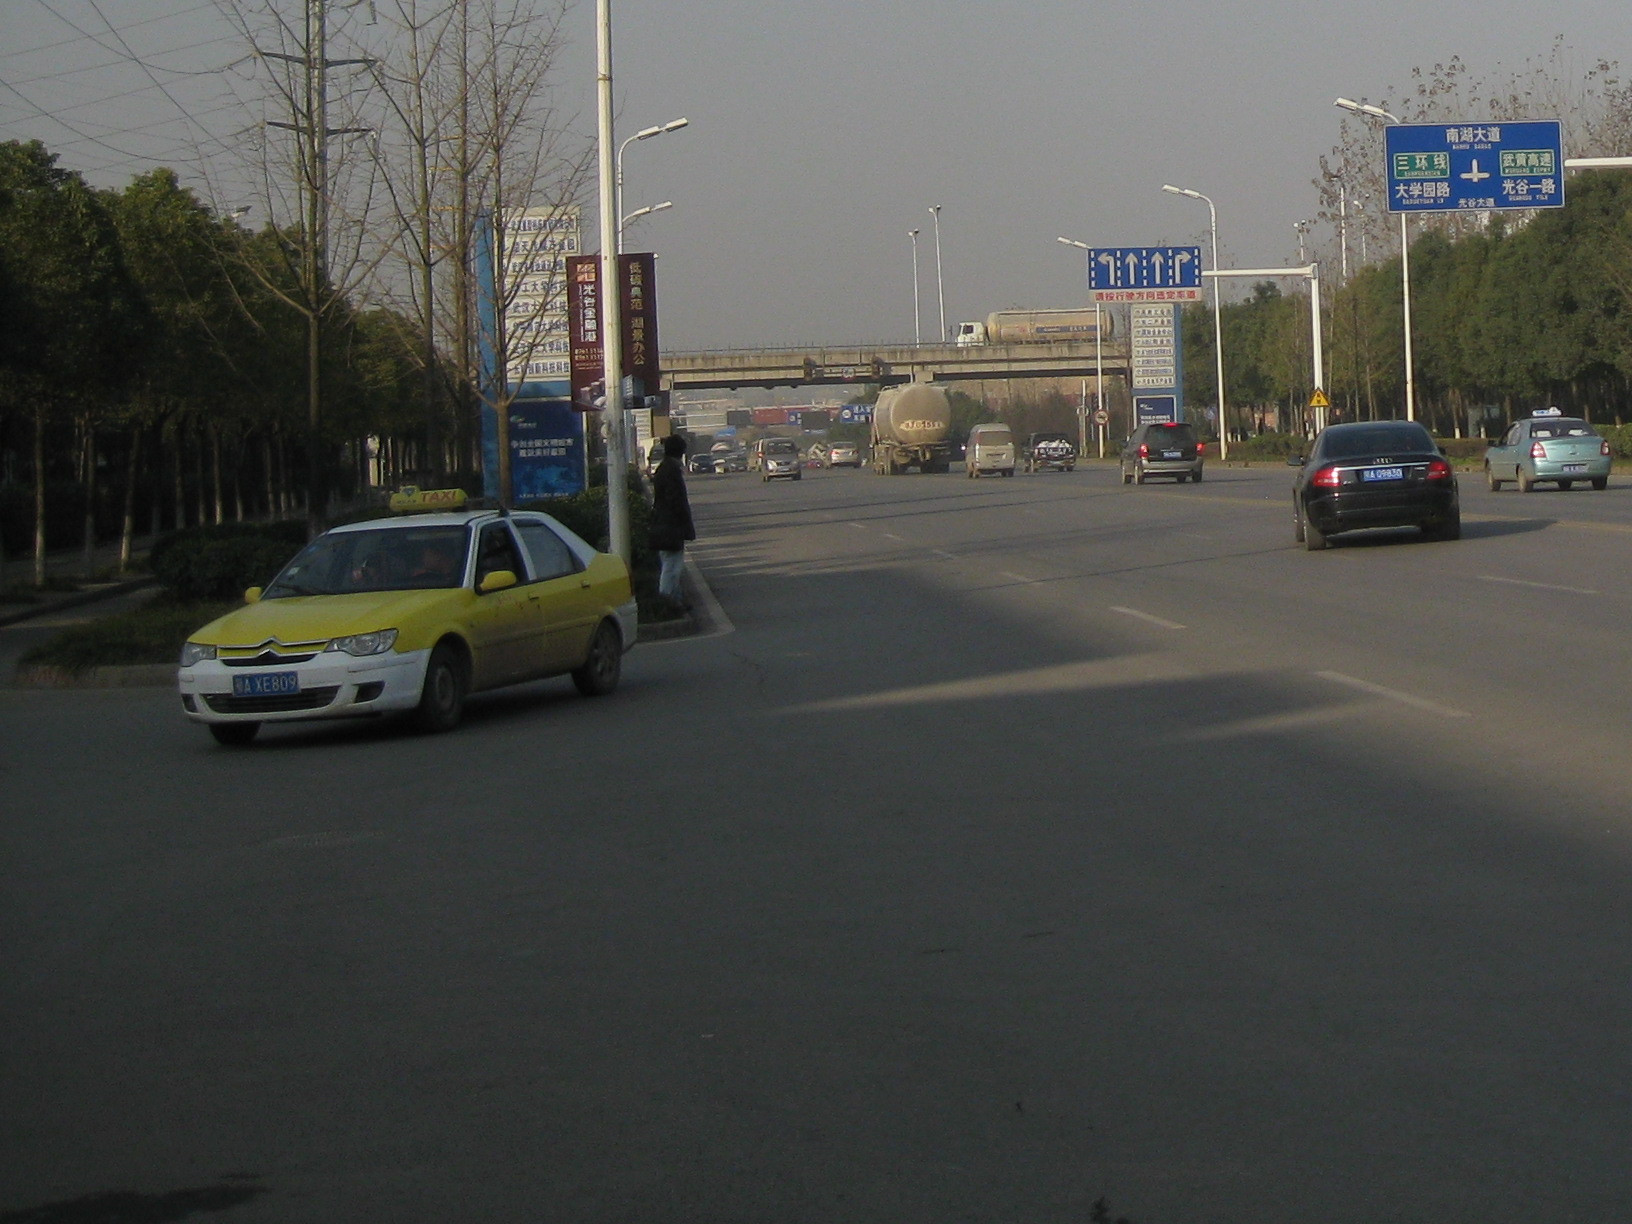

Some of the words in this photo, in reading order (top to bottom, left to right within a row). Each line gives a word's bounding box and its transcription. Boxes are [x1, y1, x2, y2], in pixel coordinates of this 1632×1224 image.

[1446, 127, 1501, 143] 南湖大道
[1397, 155, 1447, 171] 三环线
[1503, 152, 1552, 167] 武黄高速
[1395, 182, 1450, 198] 大学园路
[1502, 178, 1556, 195] 光谷一路
[1458, 198, 1496, 208] 光谷大道
[1095, 290, 1196, 301] 请按行驶方向选定车道
[422, 491, 456, 503] TAXI
